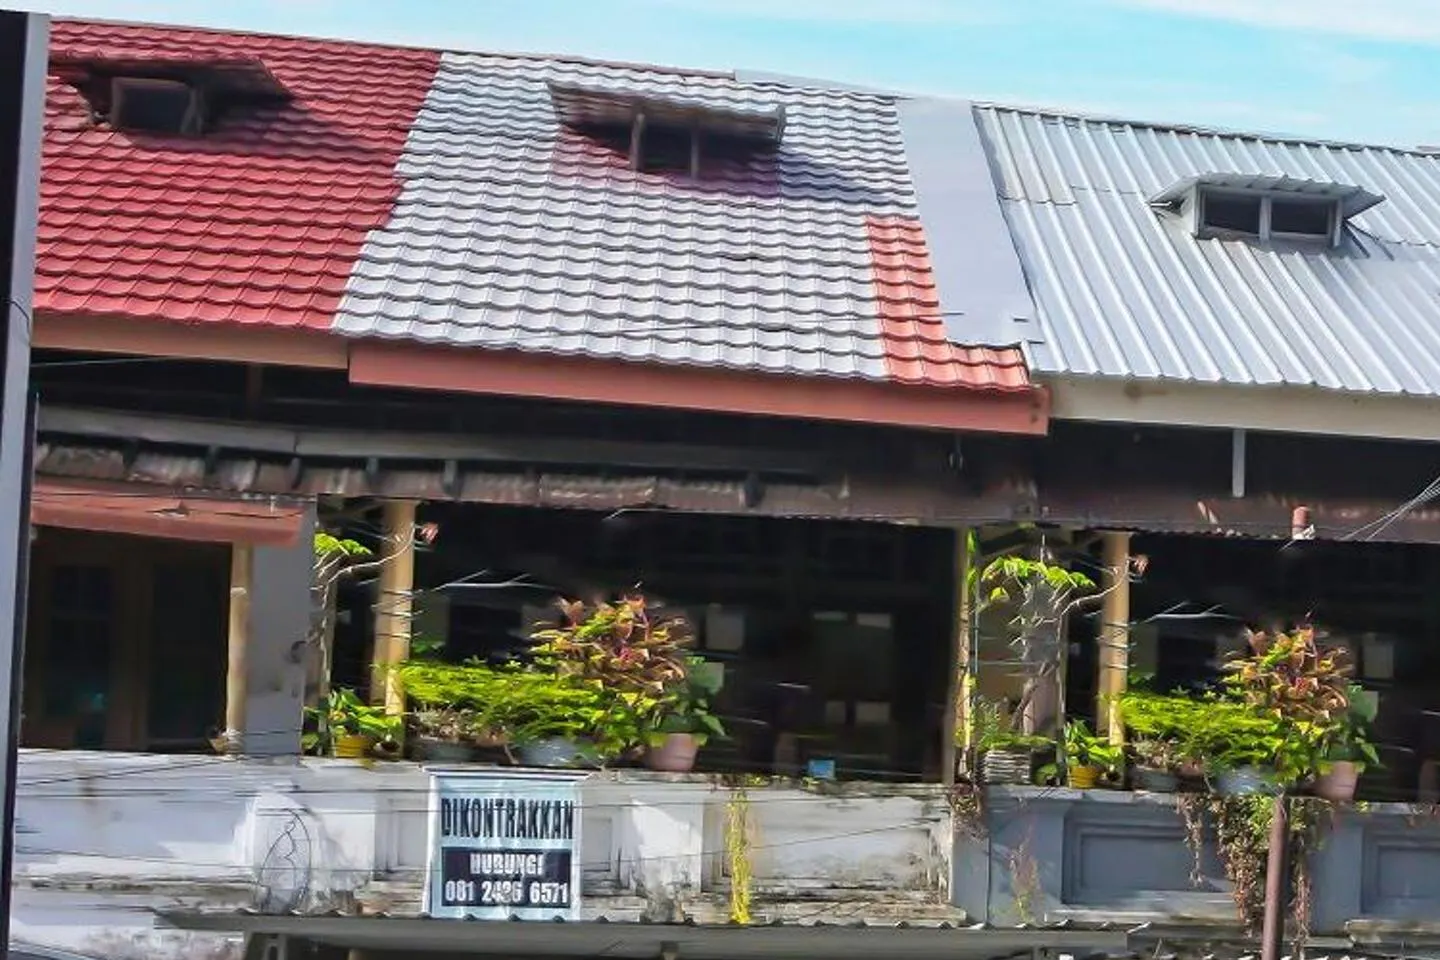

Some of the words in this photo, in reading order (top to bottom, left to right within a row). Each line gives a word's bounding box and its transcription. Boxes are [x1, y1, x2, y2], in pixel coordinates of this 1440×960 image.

[441, 798, 573, 839] DIKONTRAKKAN
[445, 880, 474, 902] 081
[529, 882, 568, 904] 6571
